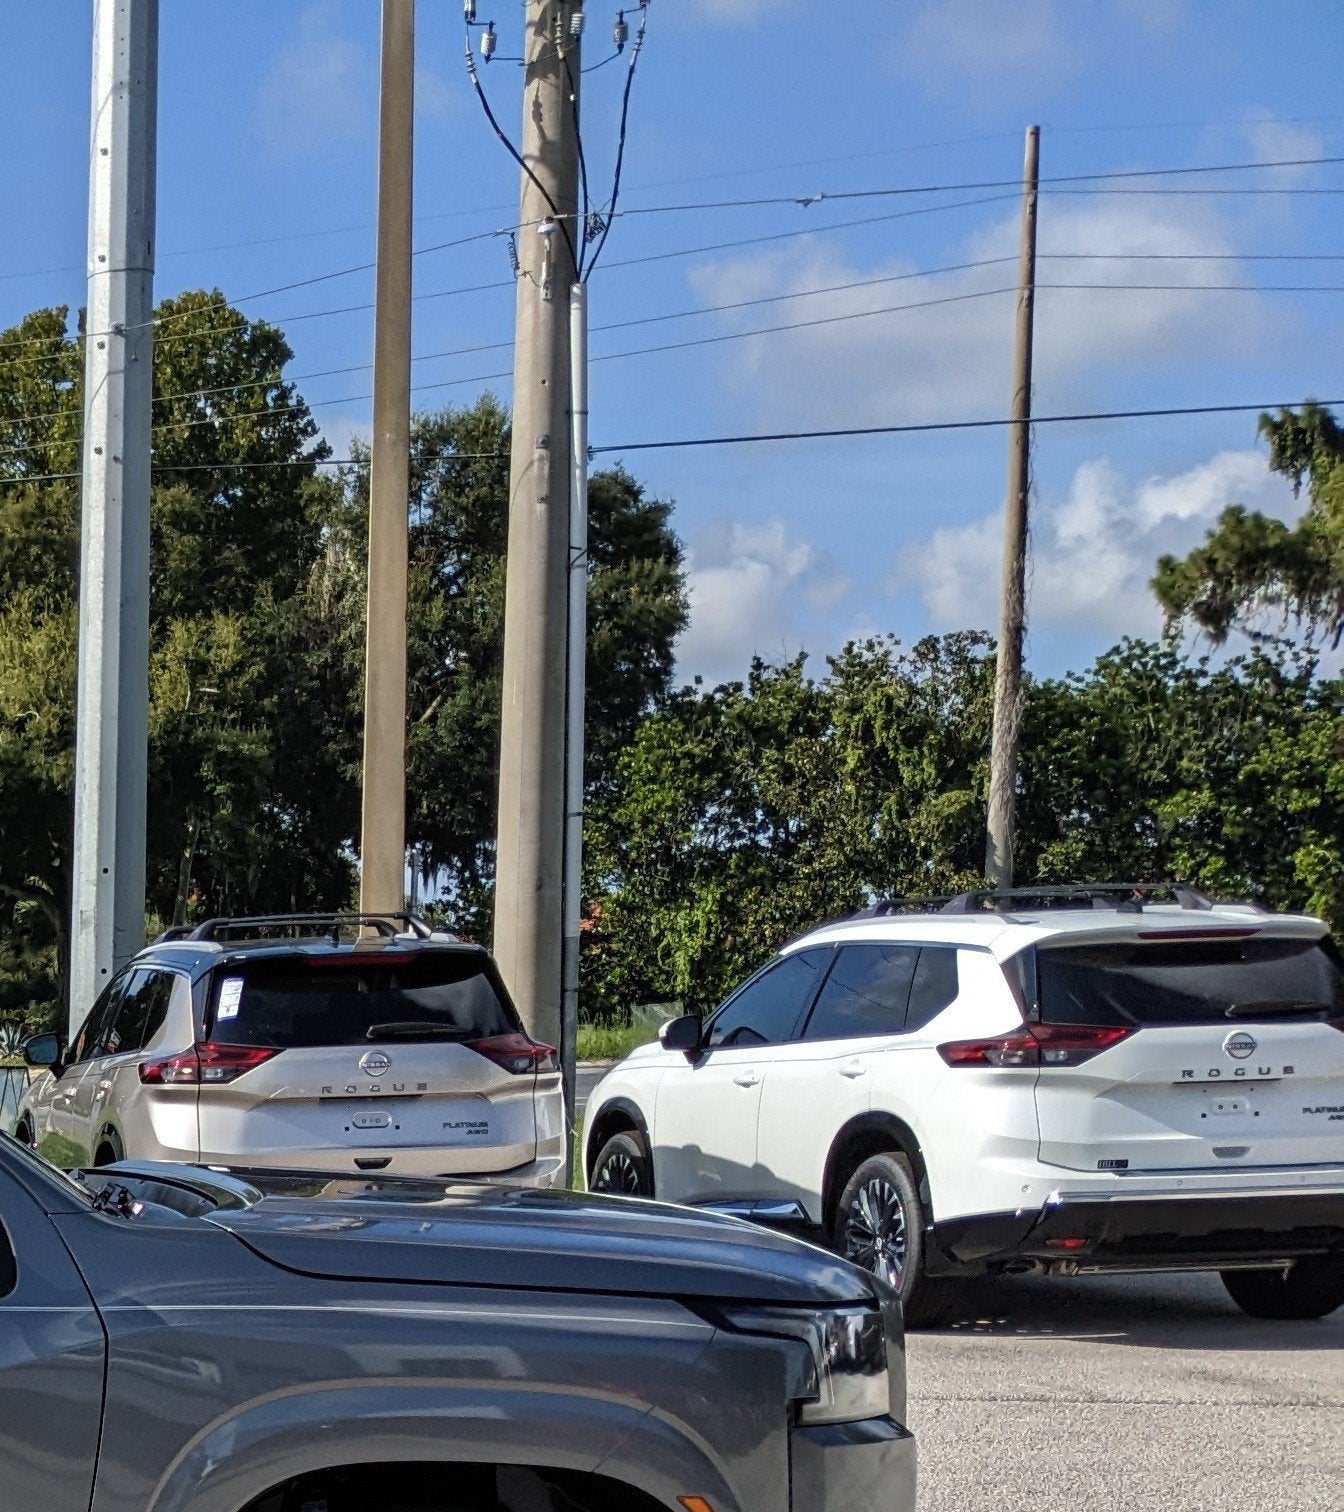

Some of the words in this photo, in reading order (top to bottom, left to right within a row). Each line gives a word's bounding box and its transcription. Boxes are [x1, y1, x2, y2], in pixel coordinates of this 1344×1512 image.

[1181, 1065, 1295, 1079] ROGUE
[321, 1082, 428, 1094] ROGUE
[1302, 1106, 1344, 1114] PLATINU
